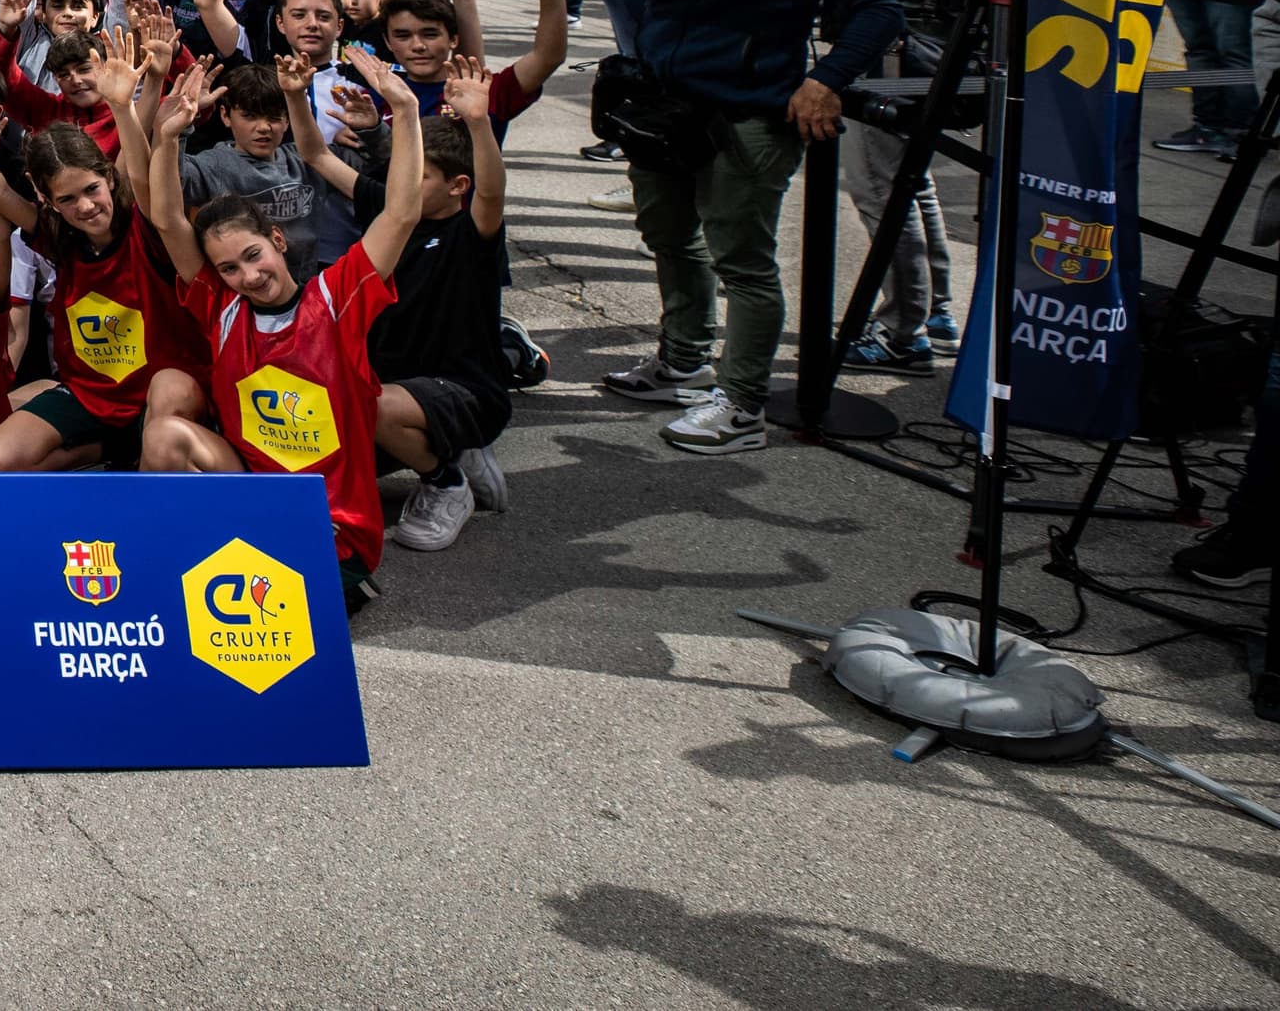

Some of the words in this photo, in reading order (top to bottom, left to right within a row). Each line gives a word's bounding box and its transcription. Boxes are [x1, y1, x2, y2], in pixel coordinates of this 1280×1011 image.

[1013, 288, 1128, 332] NDACIÓ
[83, 345, 137, 357] CRUYFF
[1011, 321, 1108, 364] ARÇA
[258, 424, 320, 443] CRUYFF
[81, 567, 103, 575] FCB
[34, 614, 165, 647] FUNDACIÓ
[210, 631, 292, 647] CRUYFF
[218, 653, 291, 662] FOUNDATION
[59, 653, 148, 683] BARÇA
